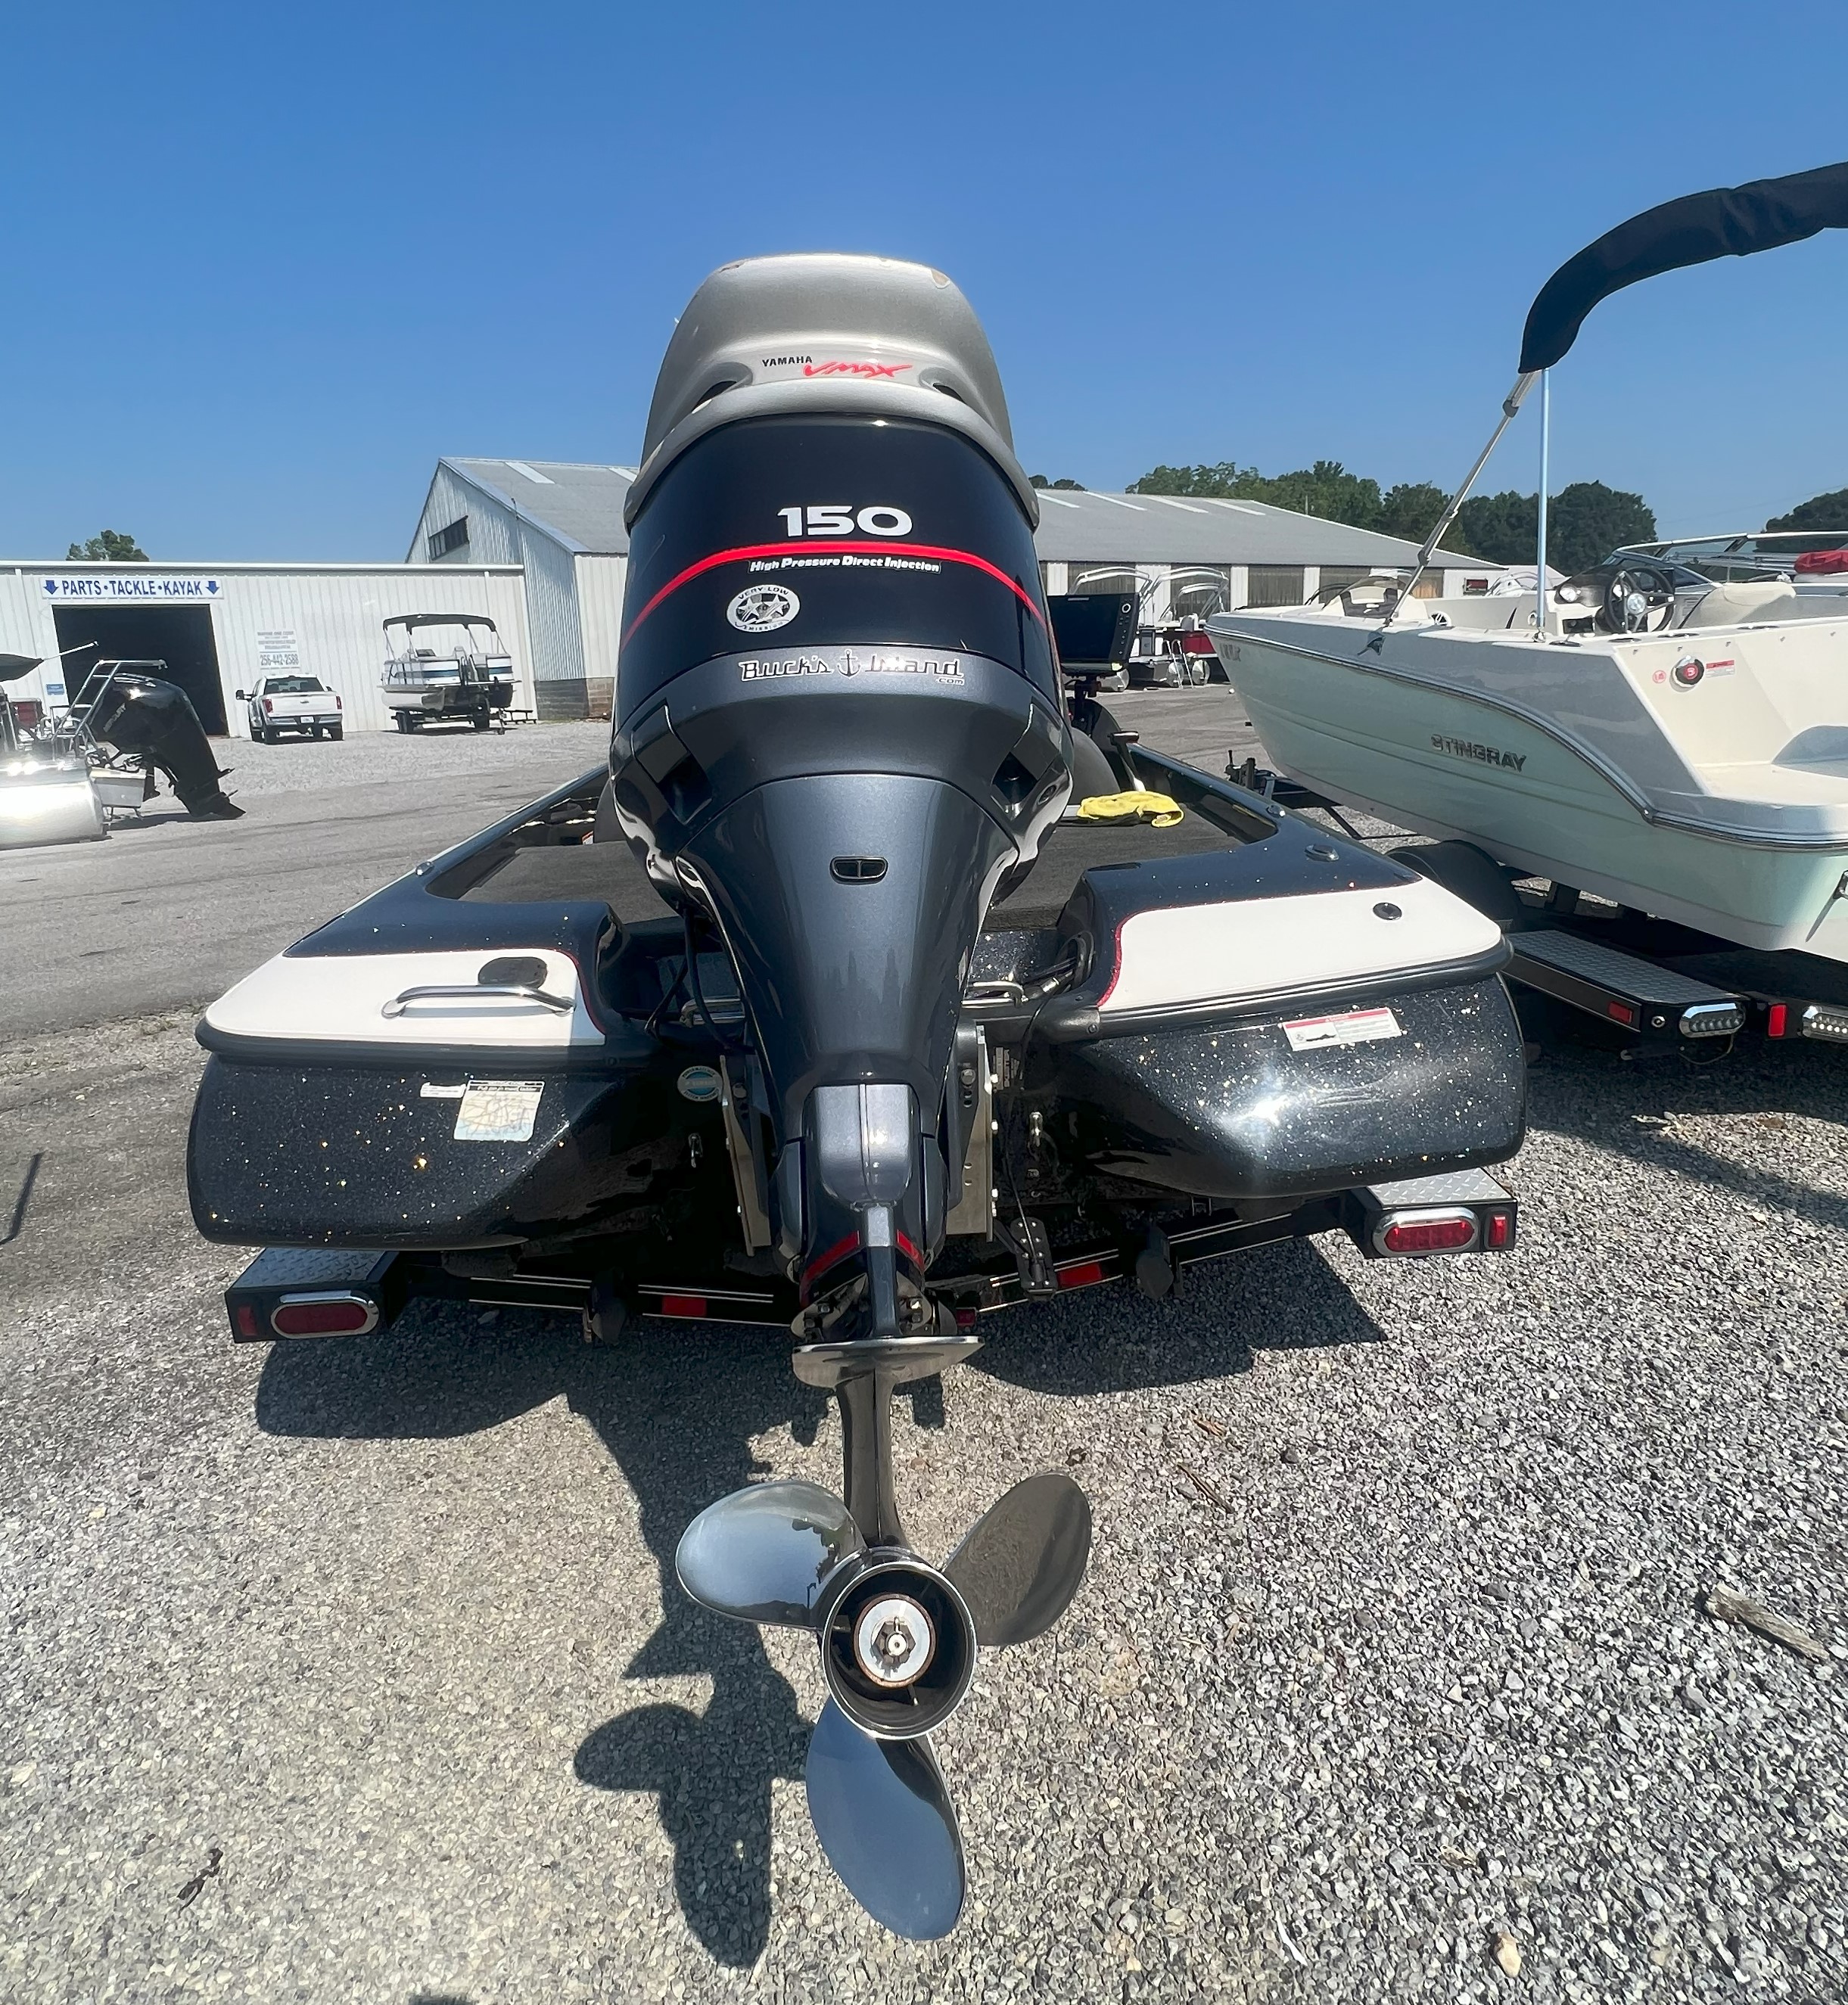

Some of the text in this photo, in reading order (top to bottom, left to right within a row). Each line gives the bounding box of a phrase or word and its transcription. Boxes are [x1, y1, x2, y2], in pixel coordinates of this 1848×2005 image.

[762, 356, 813, 367] YAMAHA
[777, 505, 913, 537] 150
[750, 555, 939, 572] High Pressure Direct Injection
[61, 580, 203, 595] PARTS TACKLE KAYAK
[738, 586, 789, 599] VERY LOW
[739, 655, 834, 681] Buck's
[1430, 734, 1527, 772] STINGRAY
